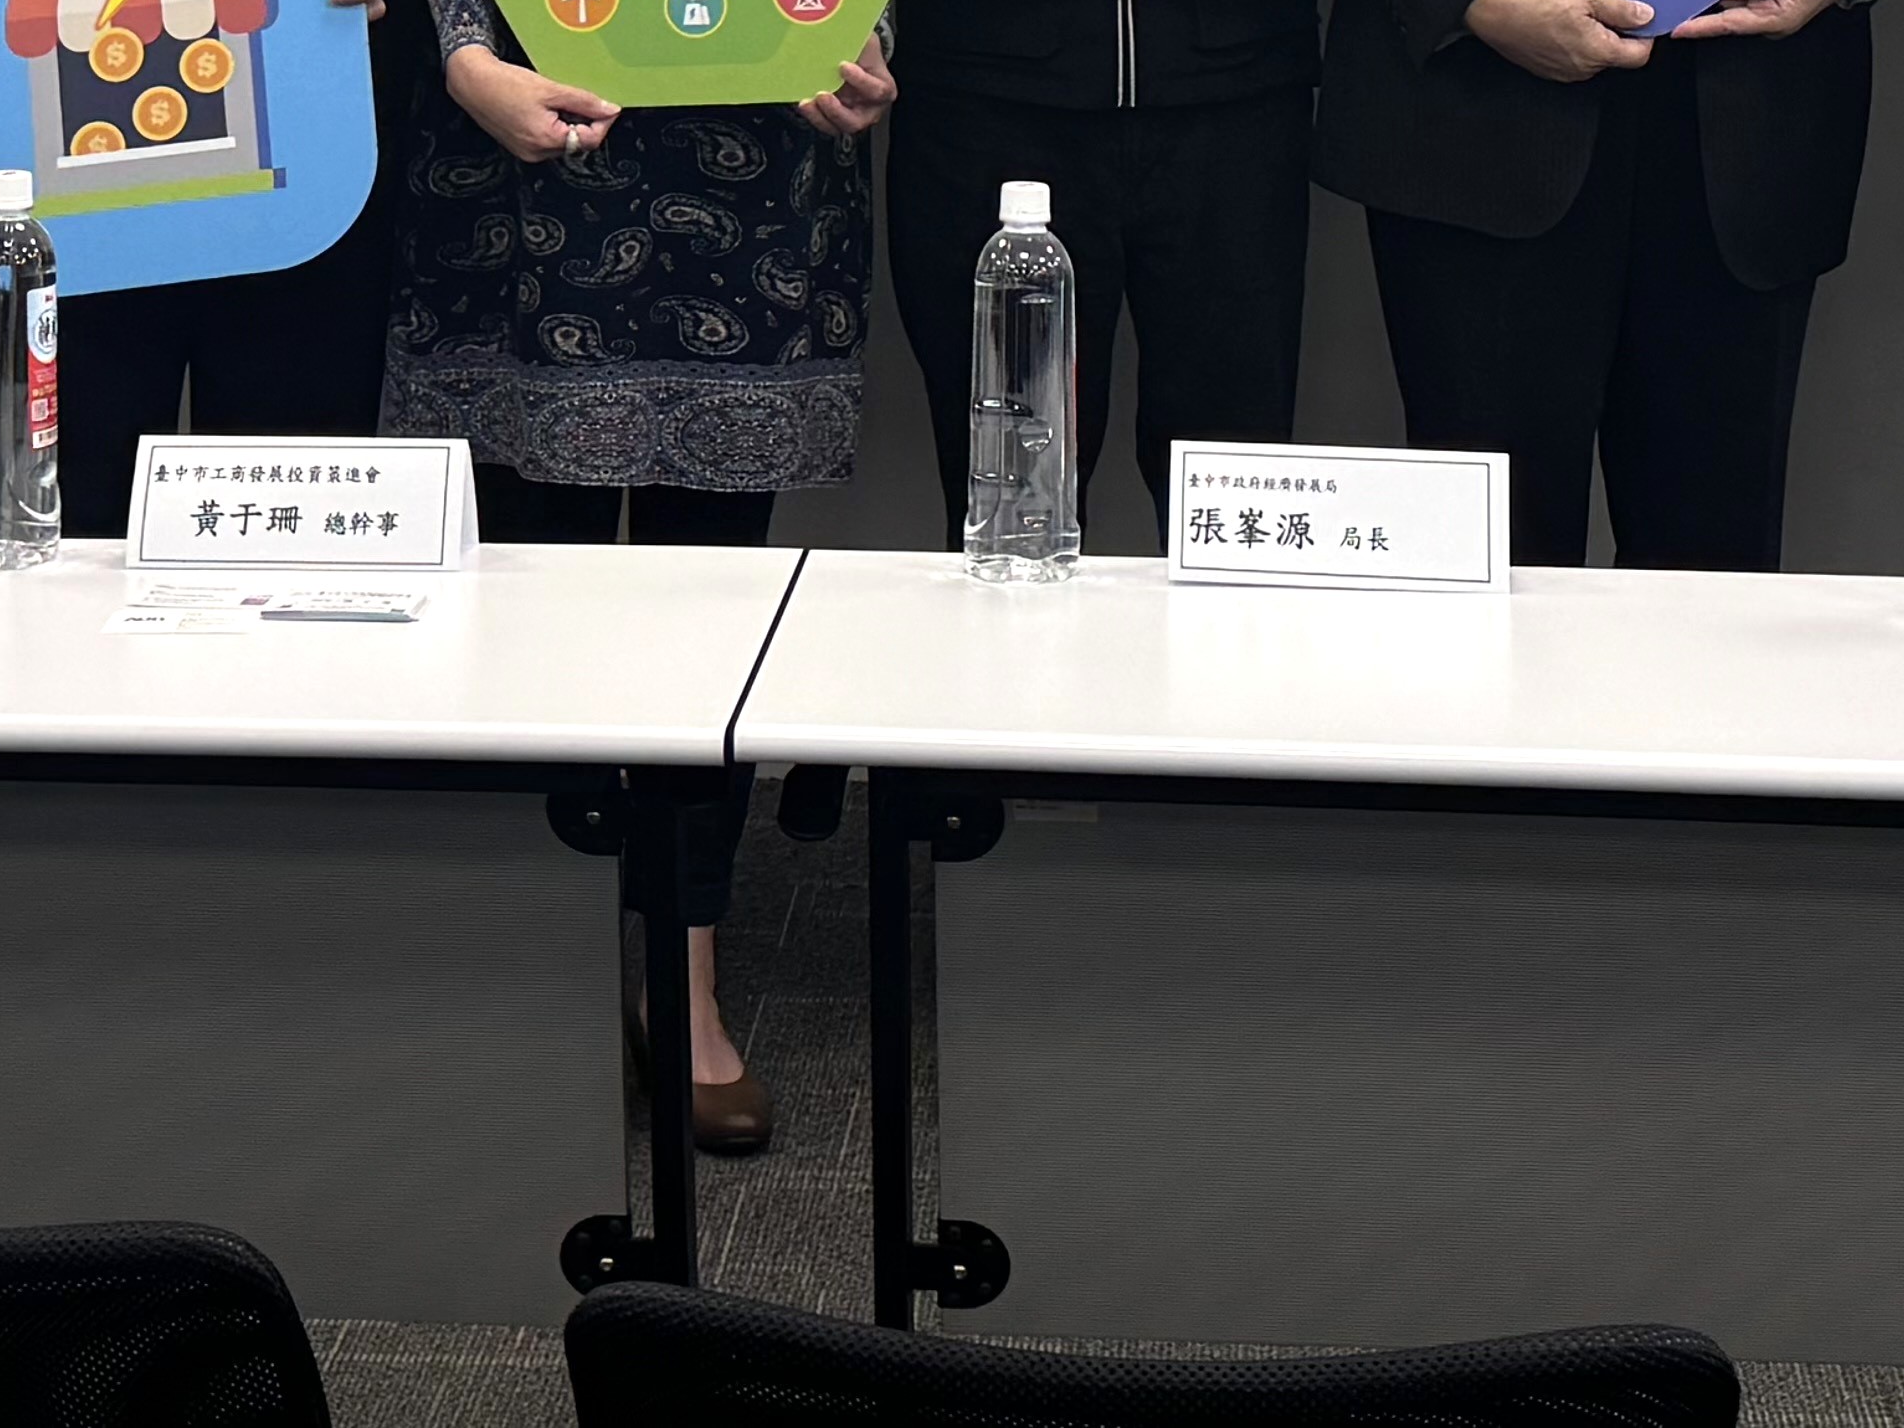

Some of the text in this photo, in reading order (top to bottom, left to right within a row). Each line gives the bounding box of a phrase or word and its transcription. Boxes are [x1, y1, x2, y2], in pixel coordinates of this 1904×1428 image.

[190, 500, 399, 537] 黃于珊 總幹事
[1340, 527, 1390, 552] 局長
